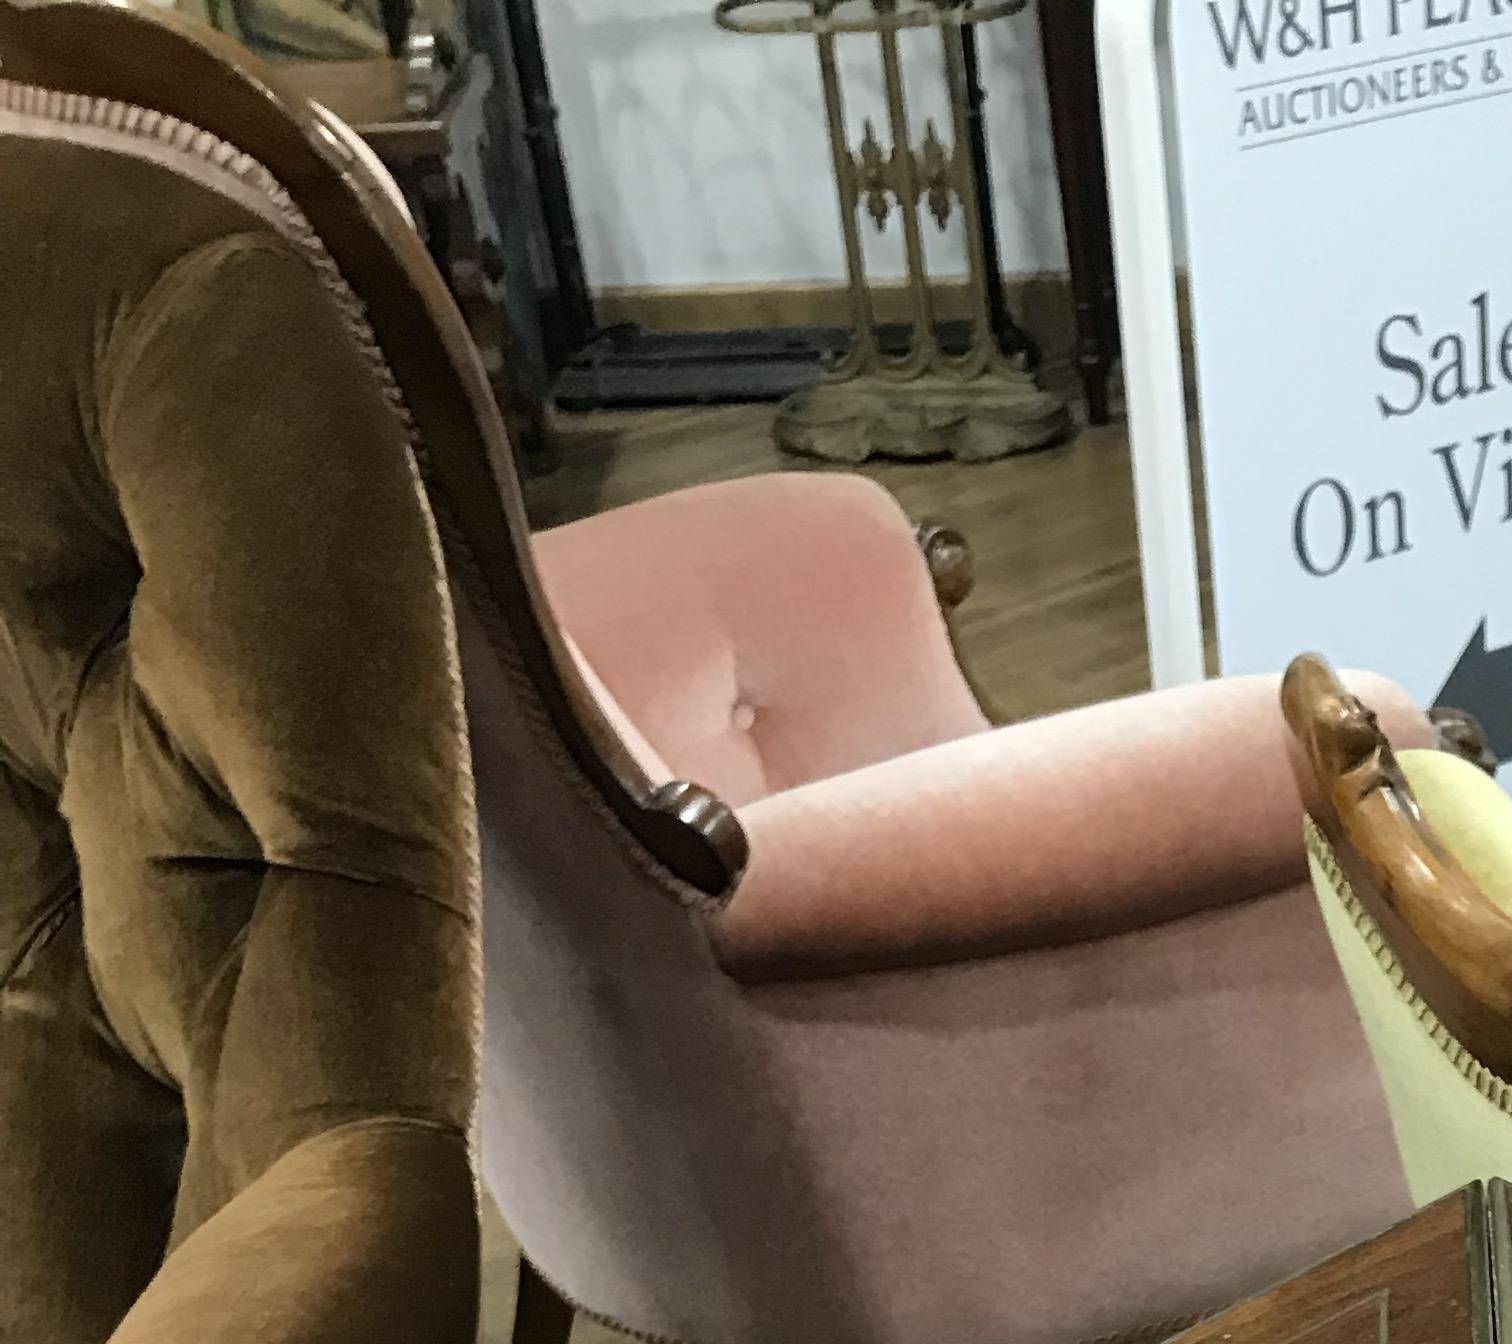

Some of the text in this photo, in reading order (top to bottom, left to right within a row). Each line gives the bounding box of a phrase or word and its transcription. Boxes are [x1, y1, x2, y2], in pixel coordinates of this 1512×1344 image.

[1207, 0, 1363, 70] W&H
[1237, 54, 1469, 137] AUCTIONEERS
[1480, 49, 1504, 84] &
[1290, 477, 1414, 579] On
